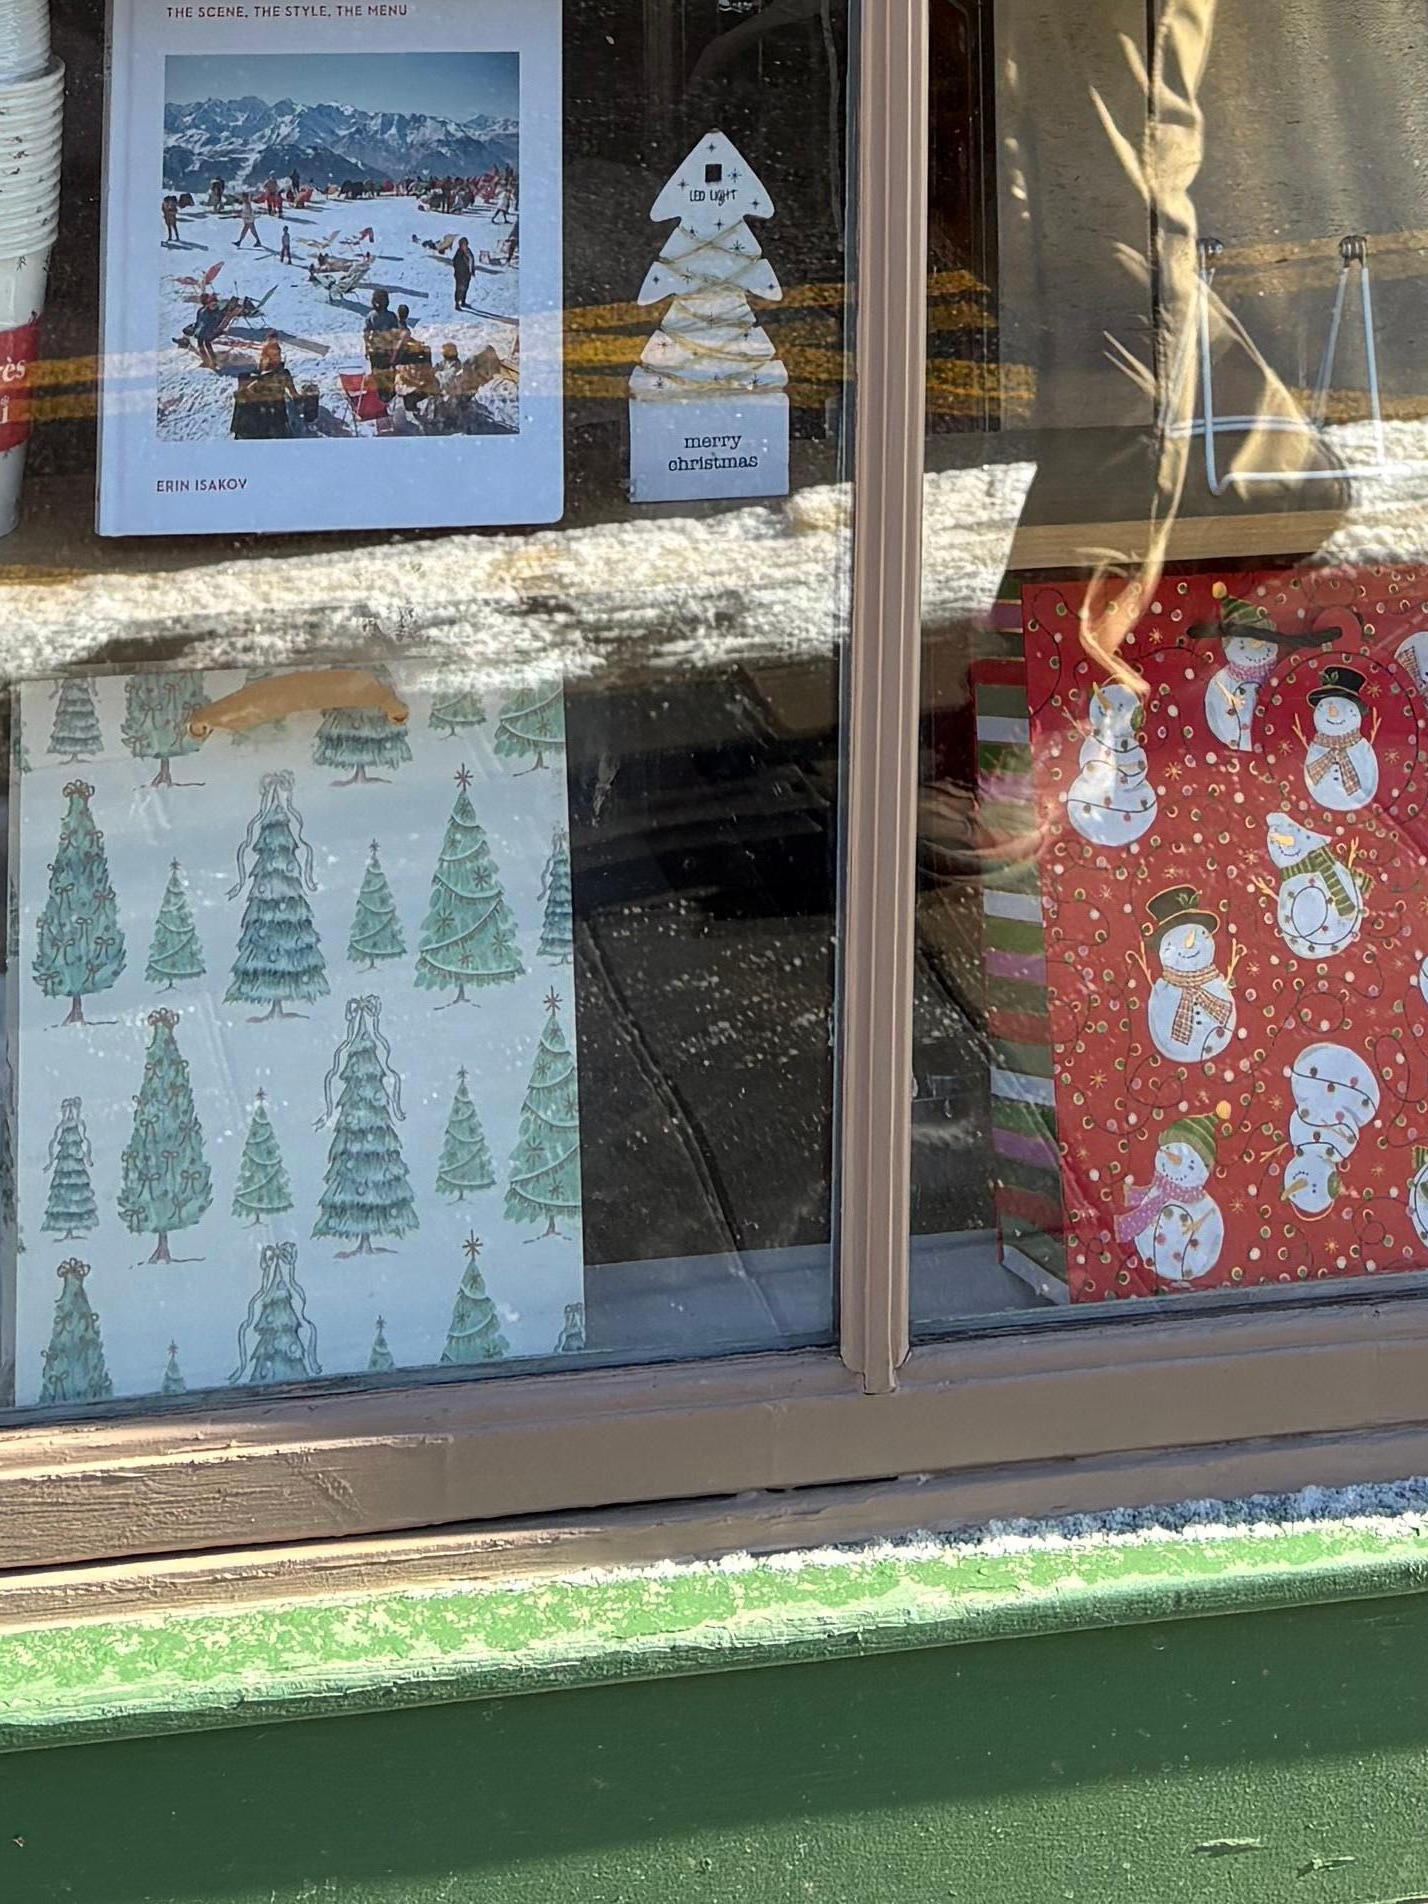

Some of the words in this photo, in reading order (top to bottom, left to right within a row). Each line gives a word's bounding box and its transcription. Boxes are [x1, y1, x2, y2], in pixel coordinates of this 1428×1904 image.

[166, 6, 192, 18] THE
[198, 5, 249, 19] SCENE,
[254, 5, 280, 17] THE
[284, 5, 332, 17] STYLE,
[337, 4, 362, 16] THE
[368, 4, 408, 16] MENU
[689, 189, 705, 202] LED
[710, 188, 738, 206] LIGHT
[684, 435, 742, 450] merry
[668, 455, 759, 471] christmas
[156, 479, 190, 493] ERIN
[195, 478, 247, 492] ISAKOV
